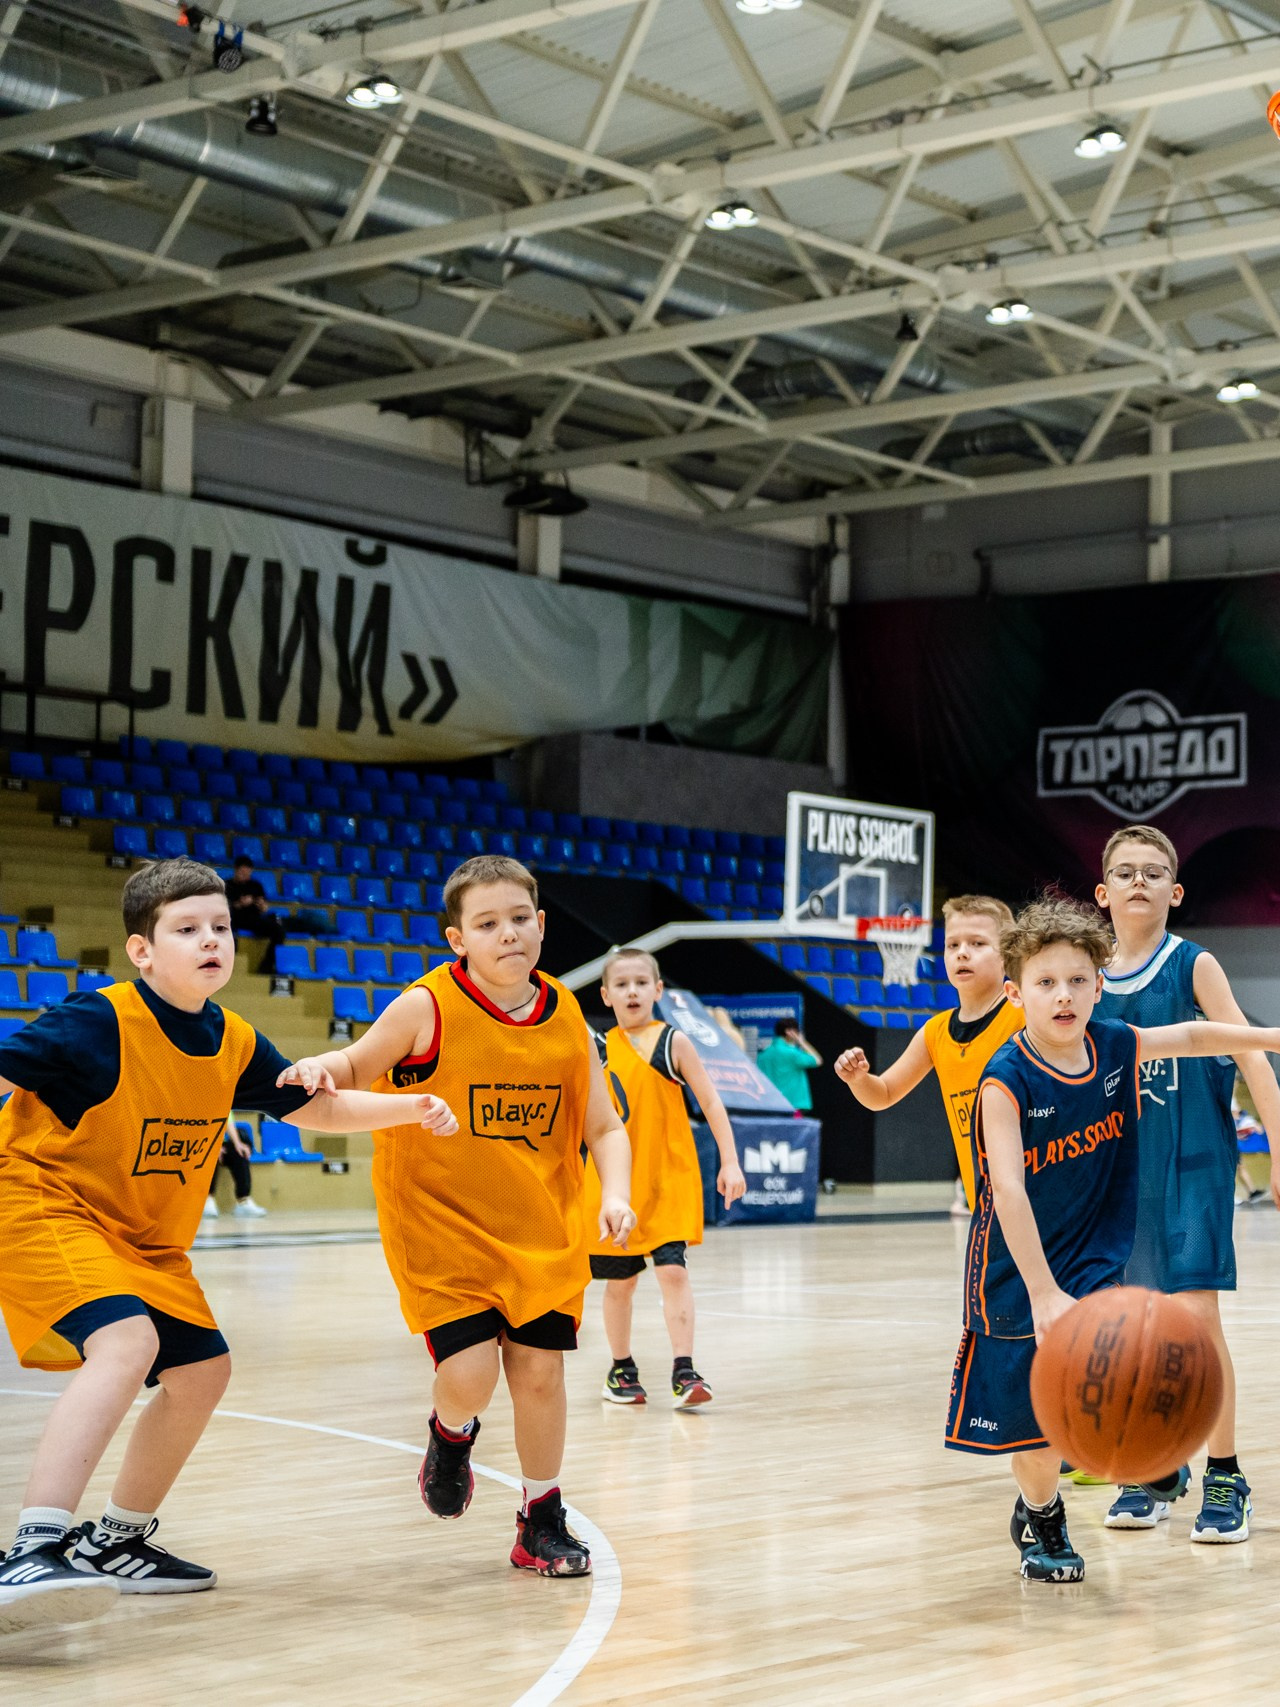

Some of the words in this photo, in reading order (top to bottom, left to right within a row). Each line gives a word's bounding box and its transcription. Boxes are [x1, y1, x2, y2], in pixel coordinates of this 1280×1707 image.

[0, 515, 458, 736] РСКИЙ»
[1048, 727, 1236, 784] ТОРПЕДО
[807, 809, 857, 855] PLAYS
[858, 816, 920, 865] SCHOOL
[494, 1083, 542, 1091] SCHOOL
[164, 1118, 209, 1126] SCHOOL
